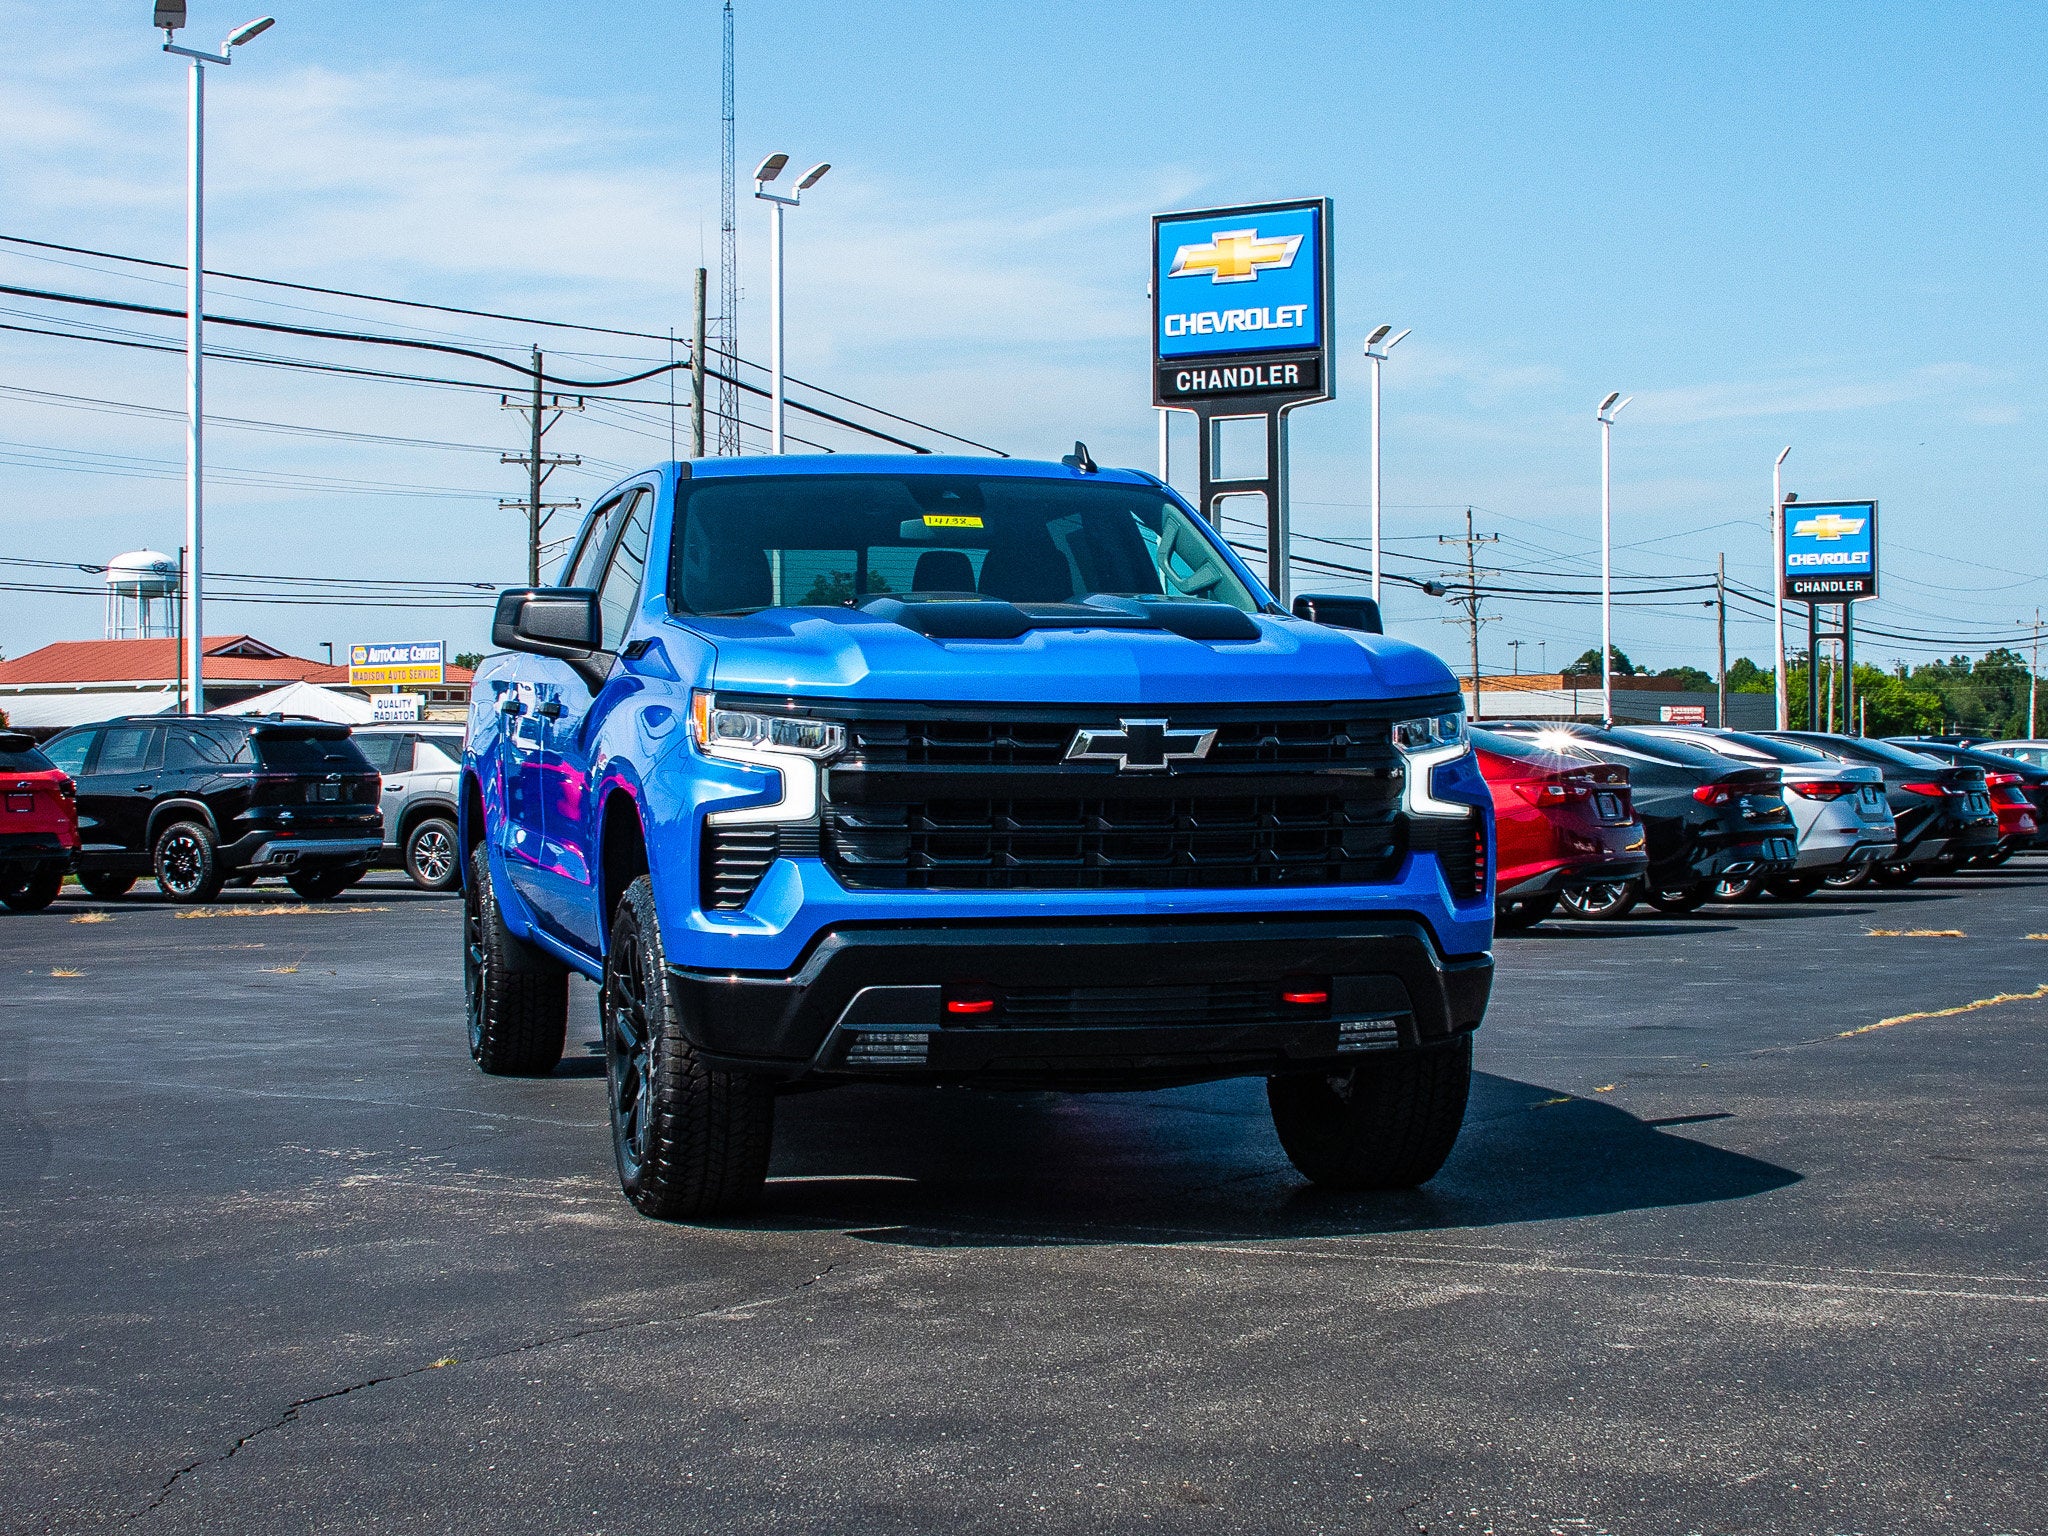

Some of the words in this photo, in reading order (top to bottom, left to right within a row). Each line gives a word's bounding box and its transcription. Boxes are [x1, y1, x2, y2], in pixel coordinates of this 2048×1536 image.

[1164, 304, 1308, 337] CHEVROLET
[1176, 364, 1299, 391] CHANDLER
[1788, 551, 1870, 566] CHEVROLET
[1794, 580, 1863, 593] CHANDLER
[352, 671, 385, 682] MADISON
[409, 668, 438, 680] SERVICE
[377, 699, 412, 709] QUALITY
[373, 710, 415, 721] RADIATOR
